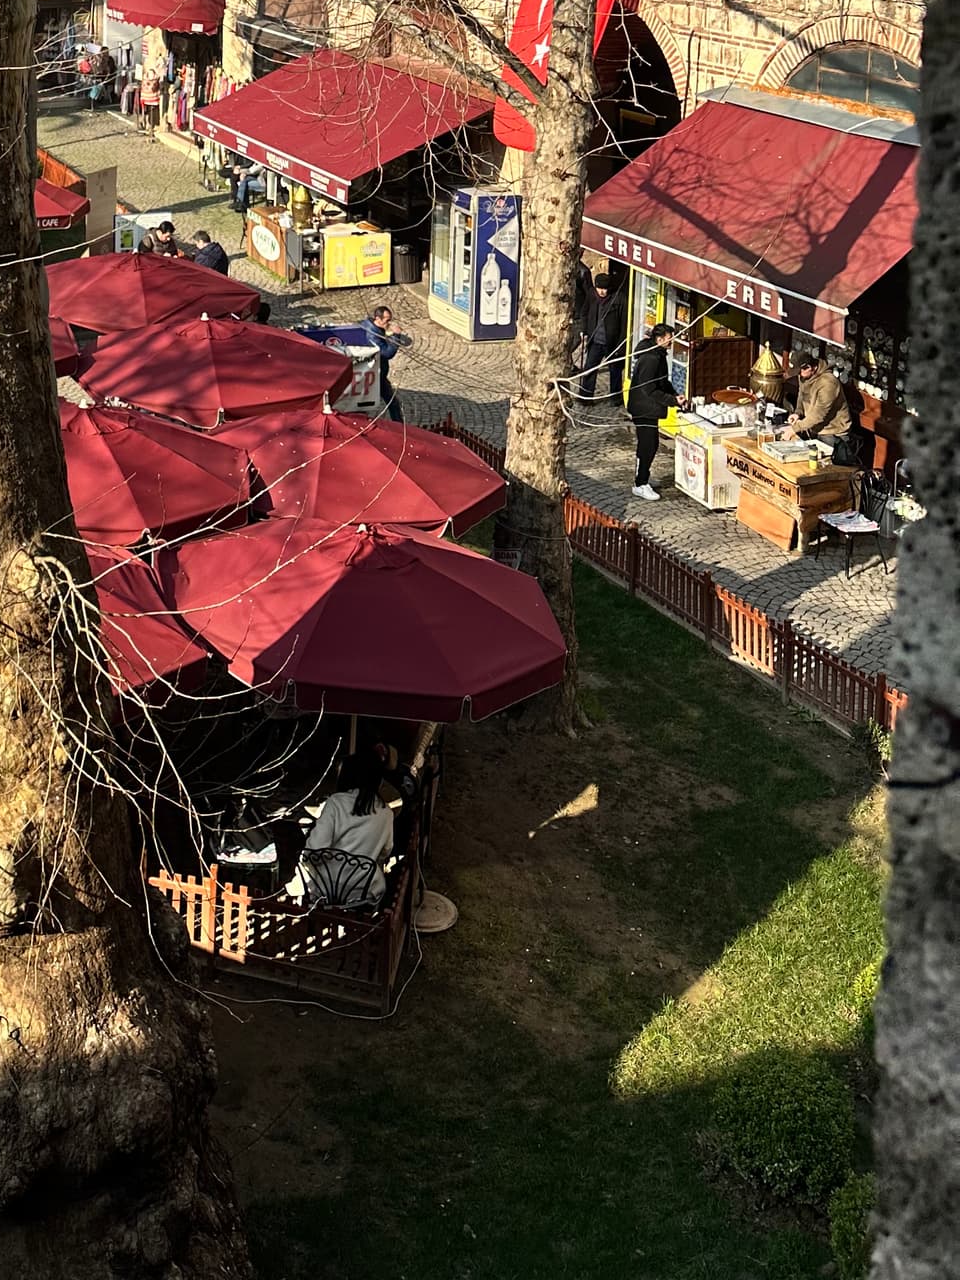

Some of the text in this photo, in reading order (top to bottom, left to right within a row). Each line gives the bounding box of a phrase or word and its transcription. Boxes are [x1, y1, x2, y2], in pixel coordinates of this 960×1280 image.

[42, 218, 59, 227] CAFE
[604, 234, 787, 317] EREL EREL
[726, 455, 749, 475] KASA
